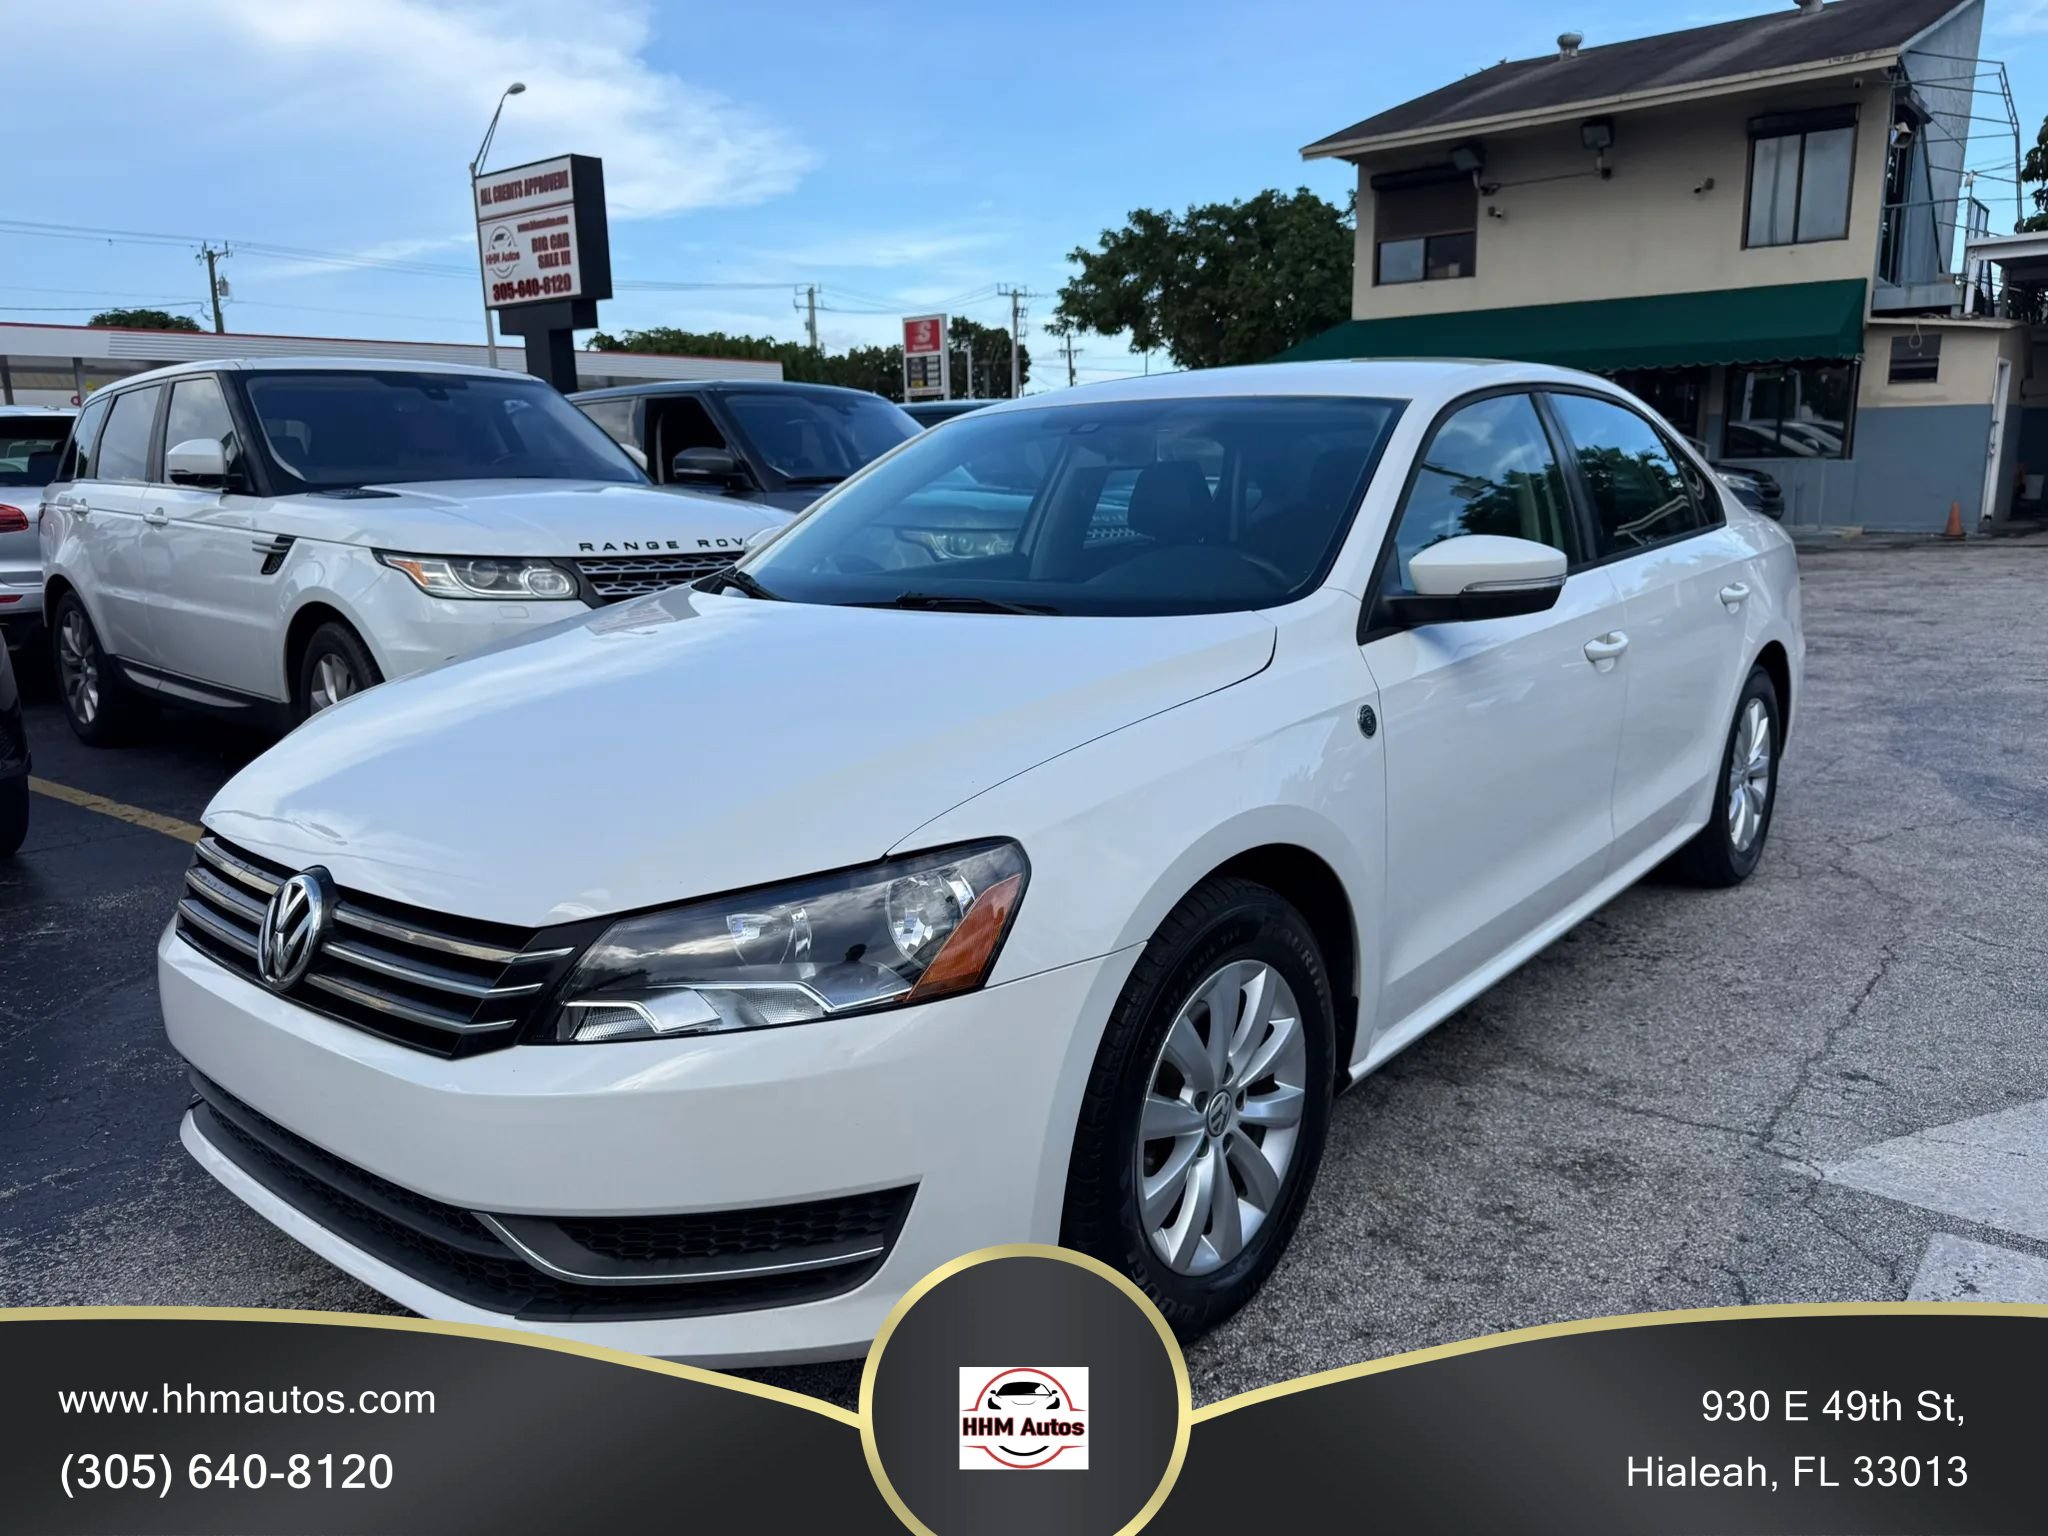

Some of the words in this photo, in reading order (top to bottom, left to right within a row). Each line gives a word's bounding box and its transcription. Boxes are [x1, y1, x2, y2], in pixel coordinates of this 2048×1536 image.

[493, 180, 523, 203] CREDITS
[531, 237, 549, 253] BIG
[550, 232, 570, 250] CAR
[538, 252, 559, 269] SALE
[493, 272, 572, 301] 305-640-8120
[579, 540, 680, 551] RANGE
